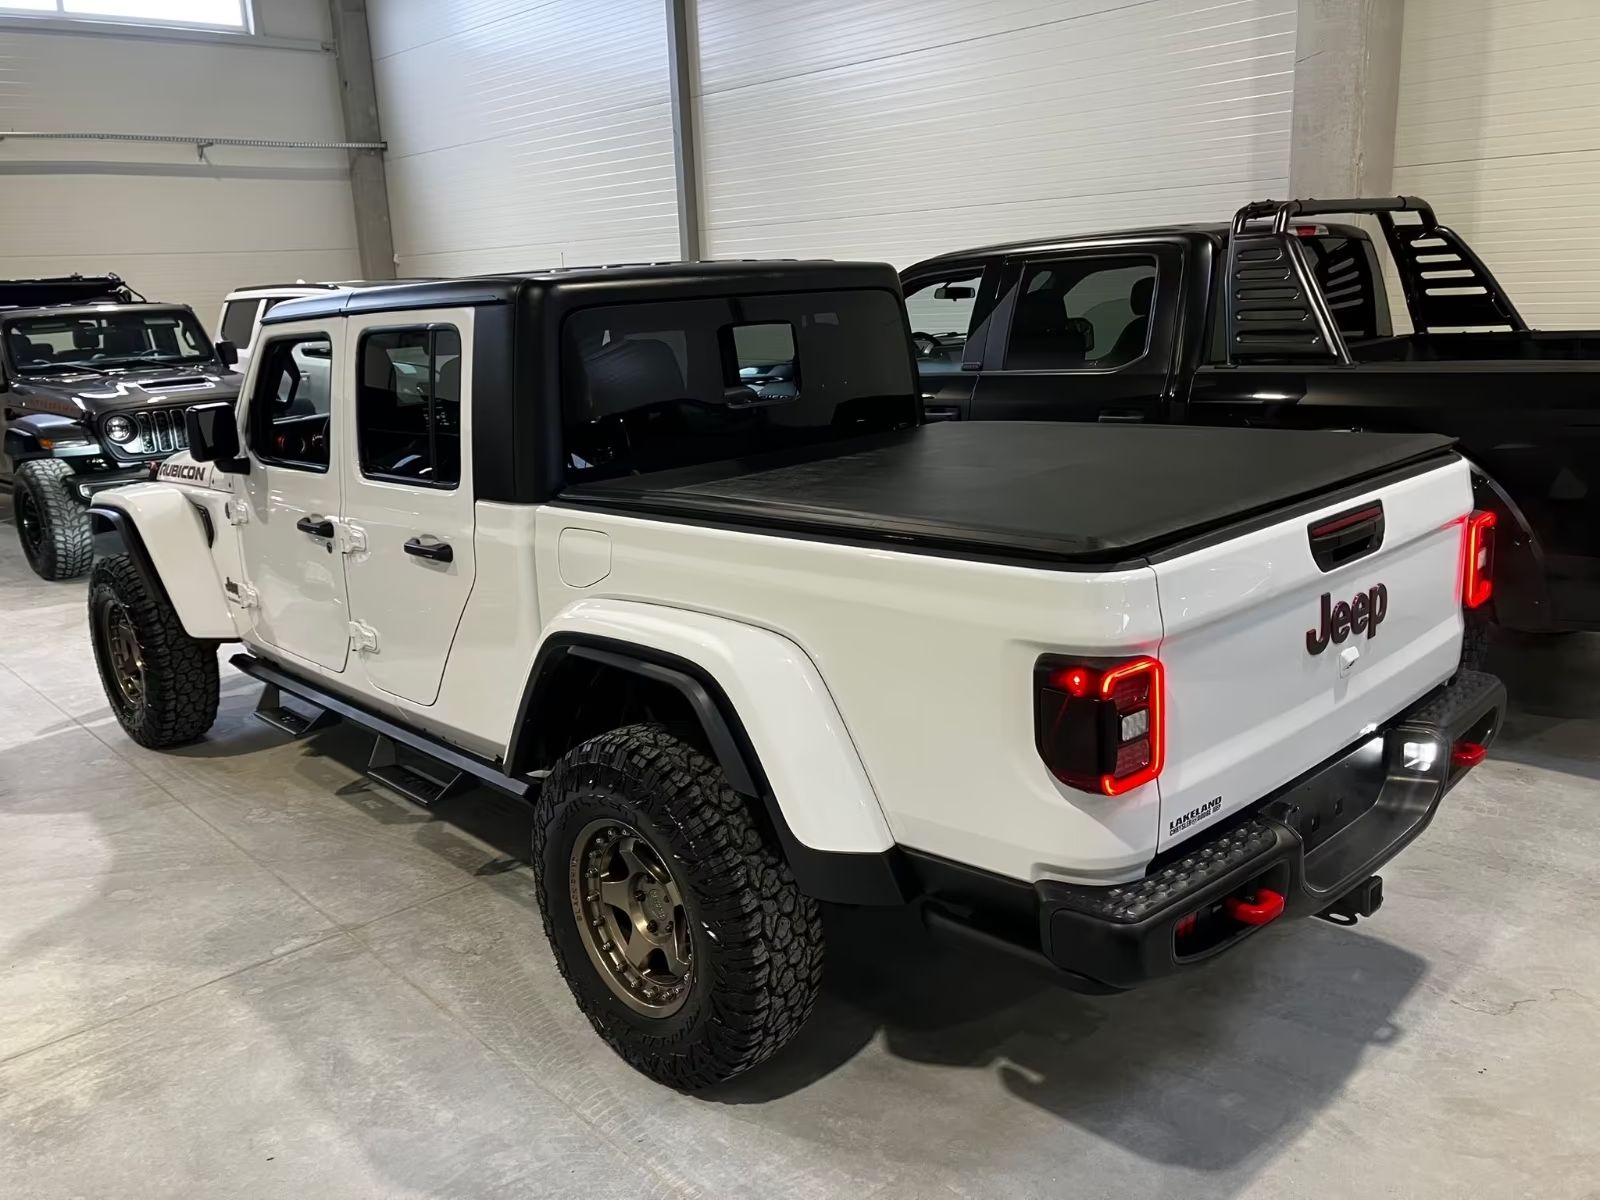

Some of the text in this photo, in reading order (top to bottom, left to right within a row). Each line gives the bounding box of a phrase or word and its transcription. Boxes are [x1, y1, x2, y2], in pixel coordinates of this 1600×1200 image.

[160, 463, 206, 481] RUBICON
[1306, 582, 1388, 656] Jeep
[1169, 795, 1222, 830] LAKELAND
